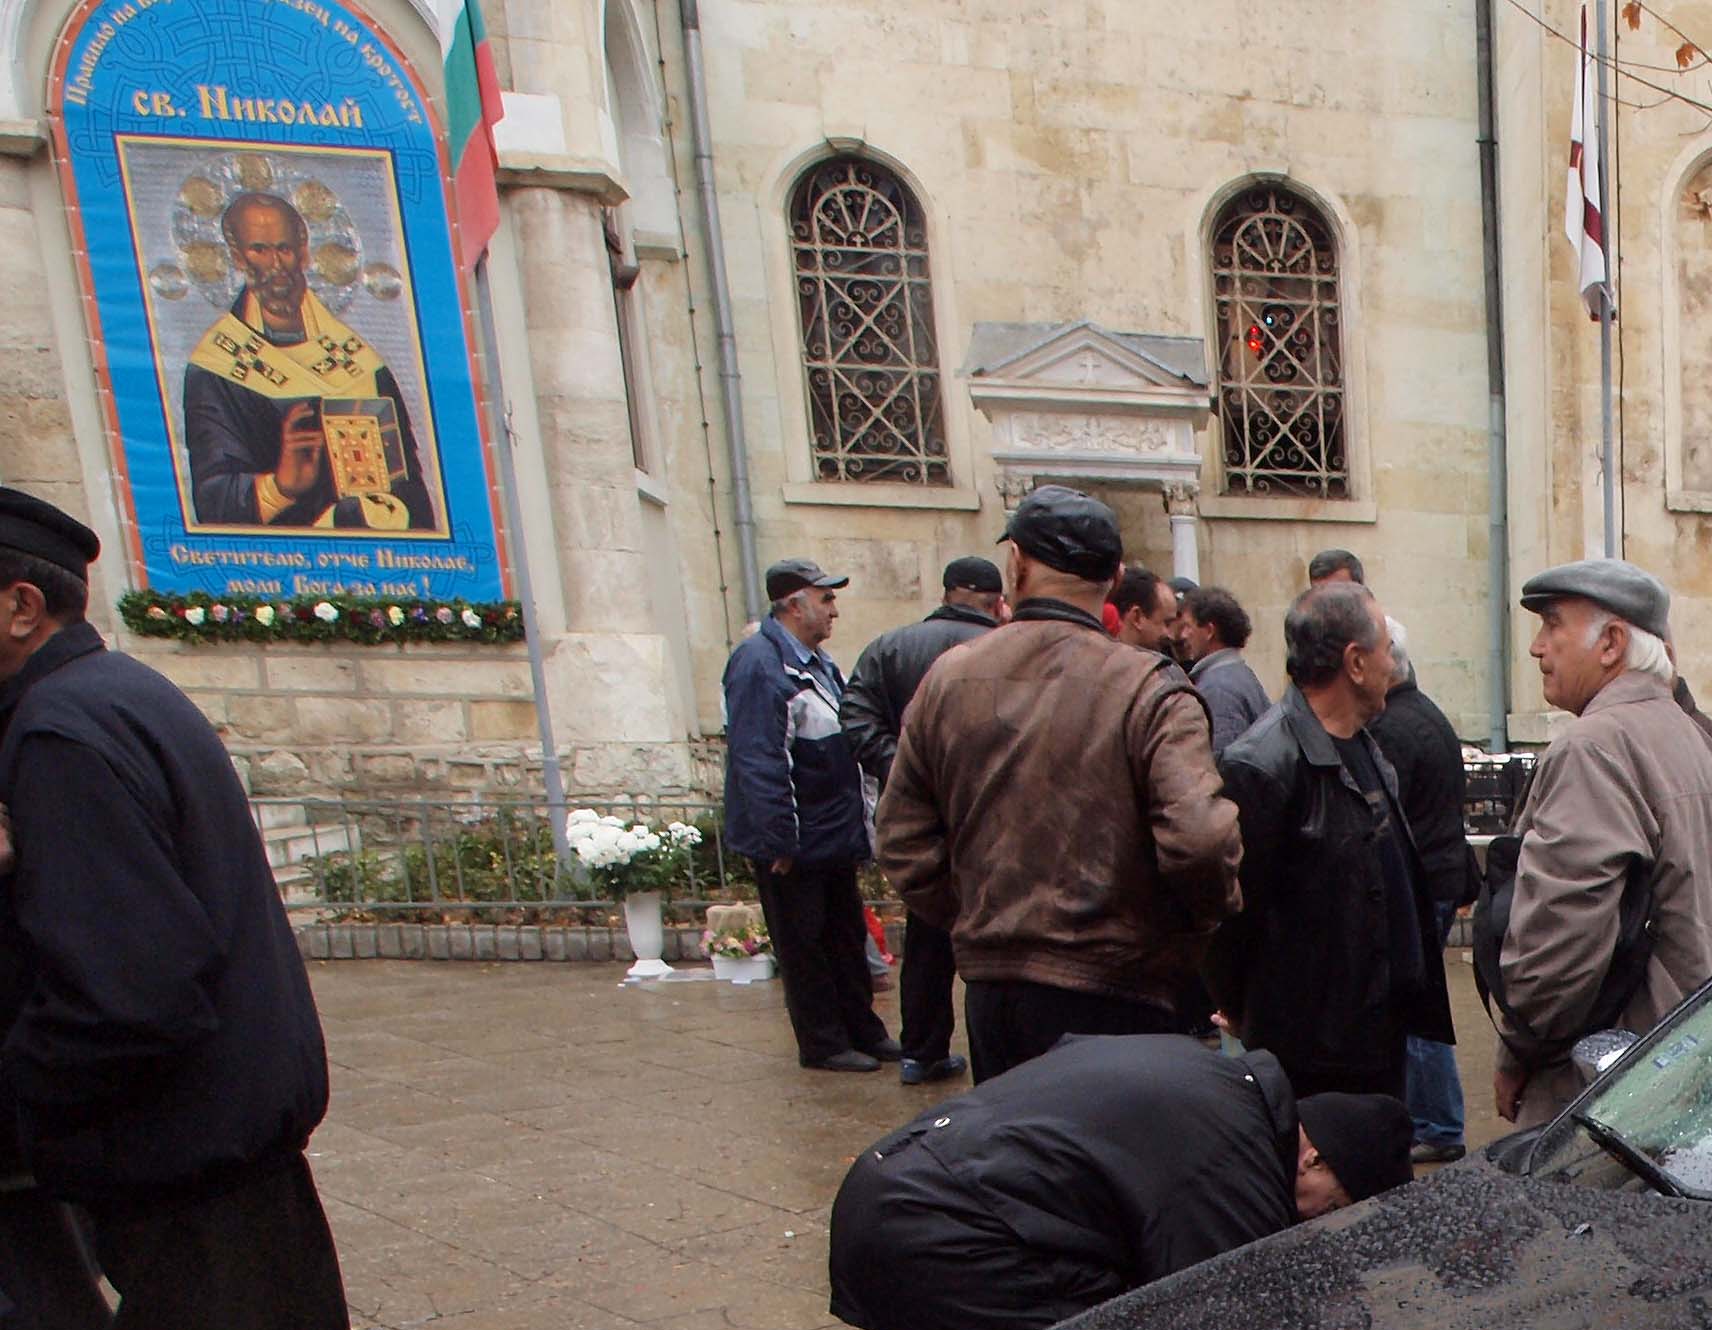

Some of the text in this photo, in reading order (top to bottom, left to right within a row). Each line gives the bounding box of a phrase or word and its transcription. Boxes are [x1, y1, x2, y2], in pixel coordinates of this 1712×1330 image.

[65, 22, 116, 106] Правило
[112, 3, 137, 25] на
[334, 20, 359, 45] на
[360, 43, 423, 125] кротост
[133, 81, 363, 128] св. Николай
[170, 544, 475, 573] Светителю, отче Николае,
[293, 575, 345, 596] Бога
[350, 581, 377, 596] за
